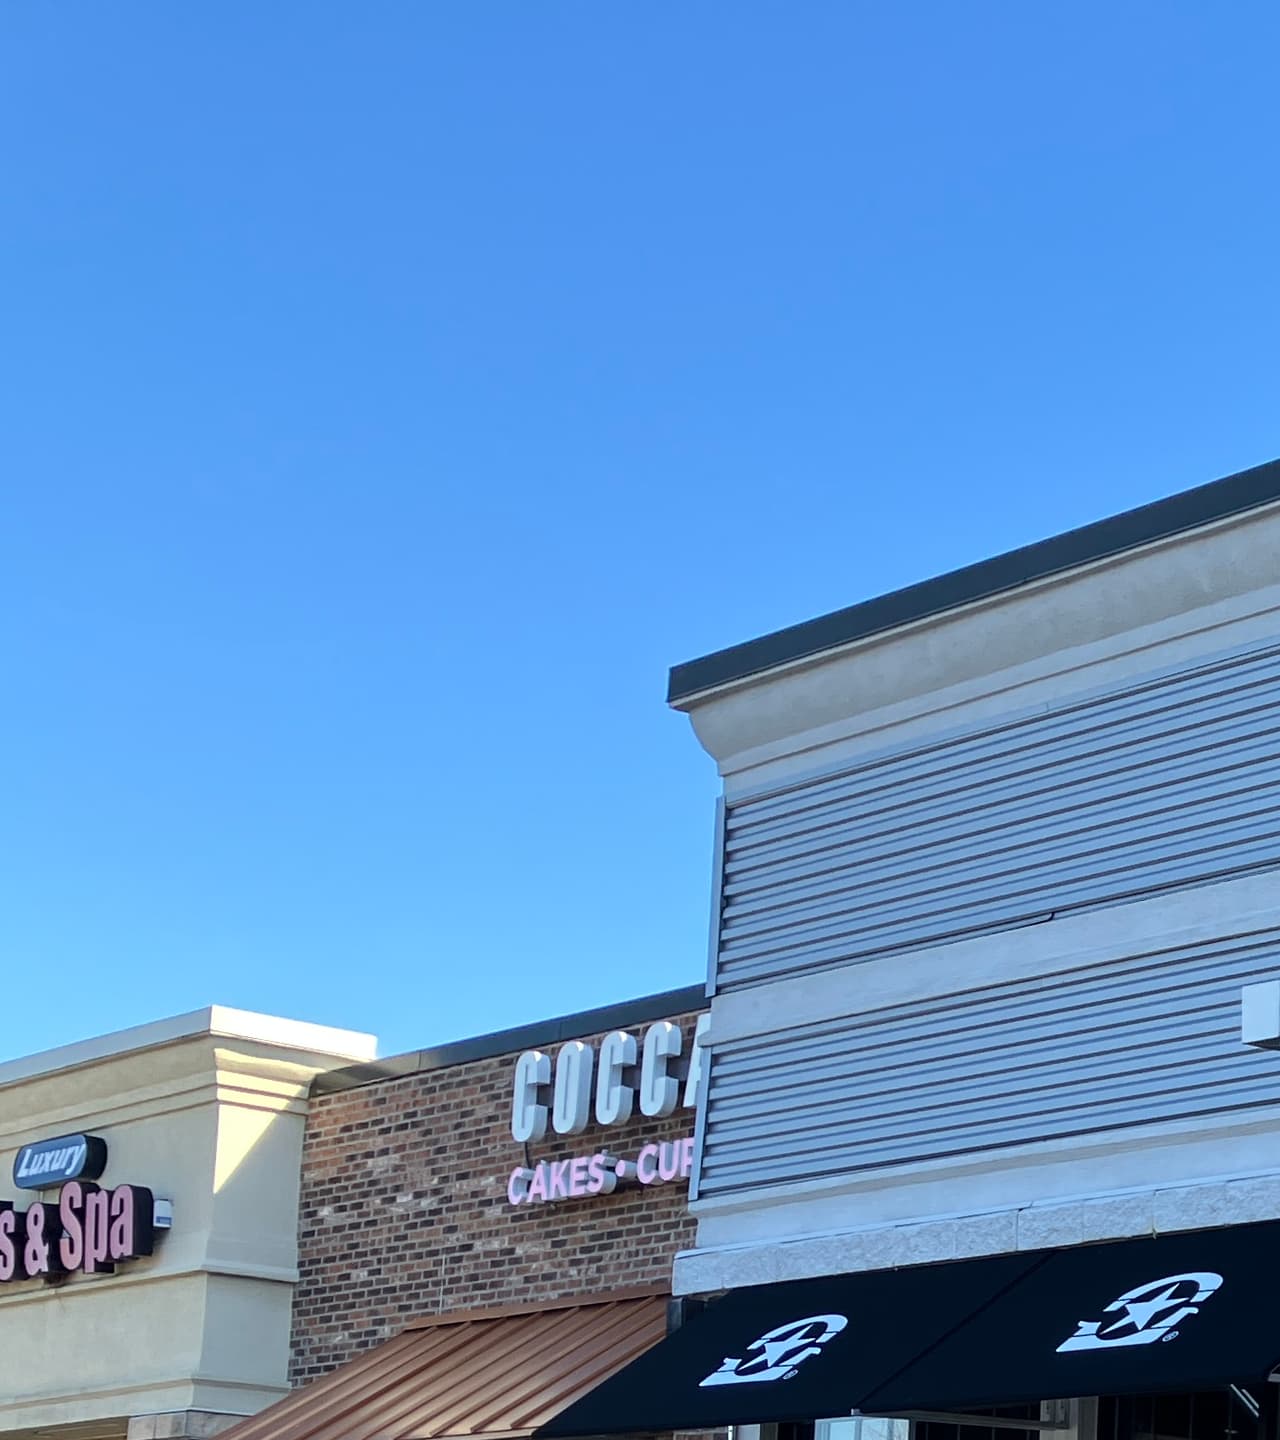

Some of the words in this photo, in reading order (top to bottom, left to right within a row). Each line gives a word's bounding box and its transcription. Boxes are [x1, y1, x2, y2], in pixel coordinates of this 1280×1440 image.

[16, 1143, 87, 1178] Luxury
[507, 1152, 616, 1206] CAKES
[23, 1202, 50, 1277] &
[59, 1181, 134, 1274] Spa
